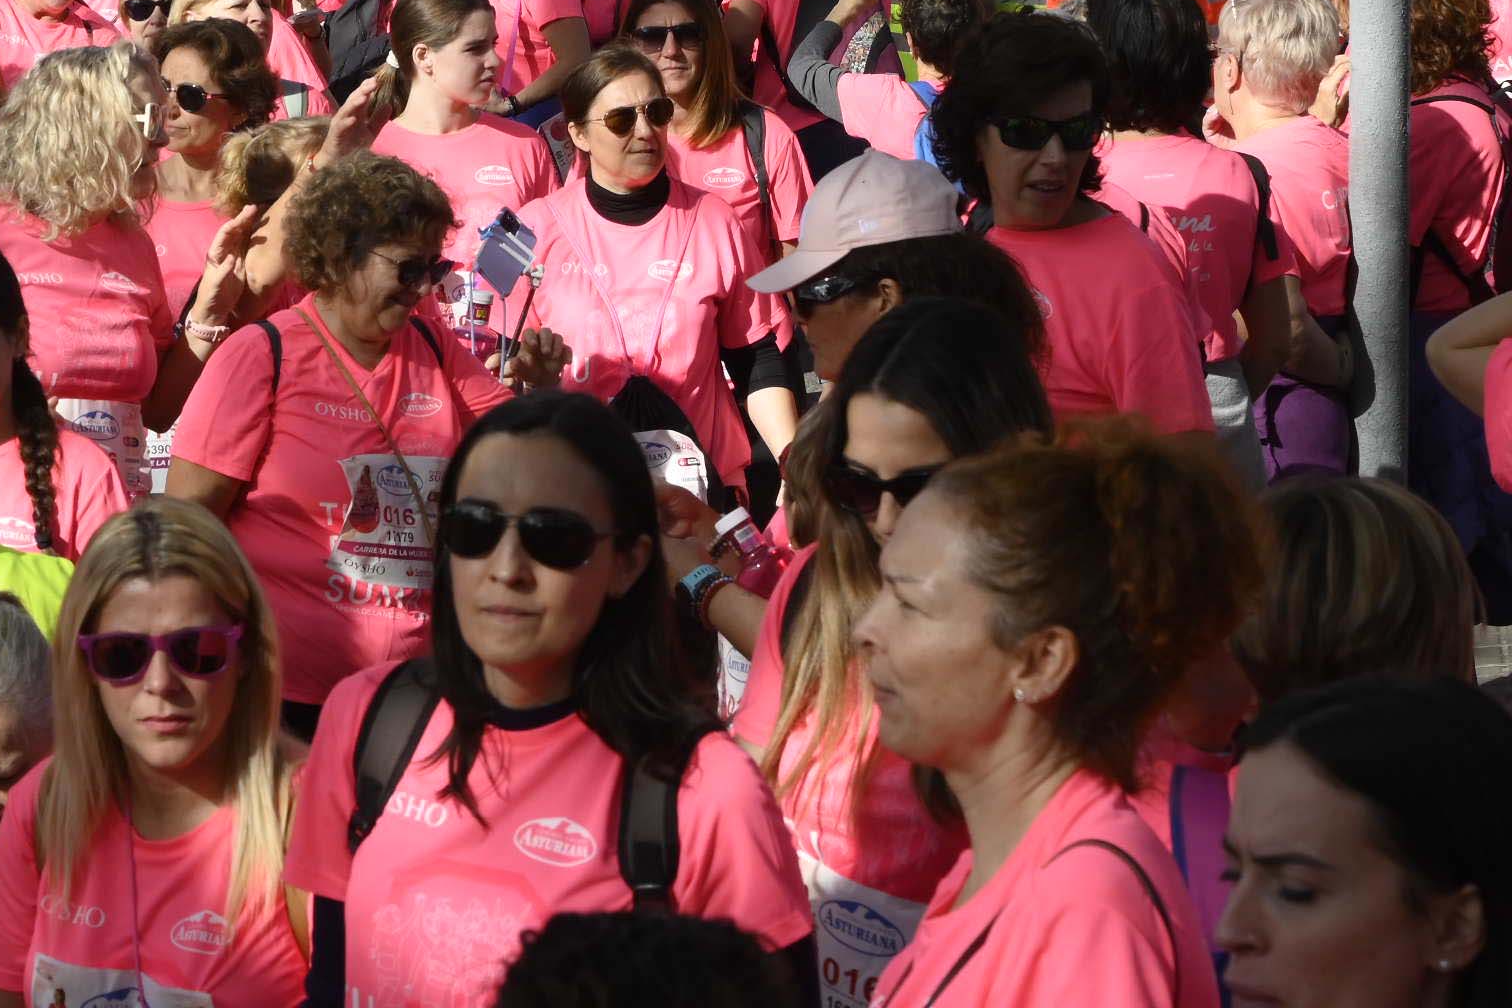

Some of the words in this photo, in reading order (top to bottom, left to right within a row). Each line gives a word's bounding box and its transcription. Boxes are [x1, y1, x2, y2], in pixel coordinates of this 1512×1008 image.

[314, 401, 373, 423] OYSHO
[319, 502, 355, 526] T
[383, 505, 416, 526] 016
[344, 558, 386, 576] OYSHO
[521, 827, 589, 858] ASTURIANA
[826, 906, 898, 954] ASTURIANA
